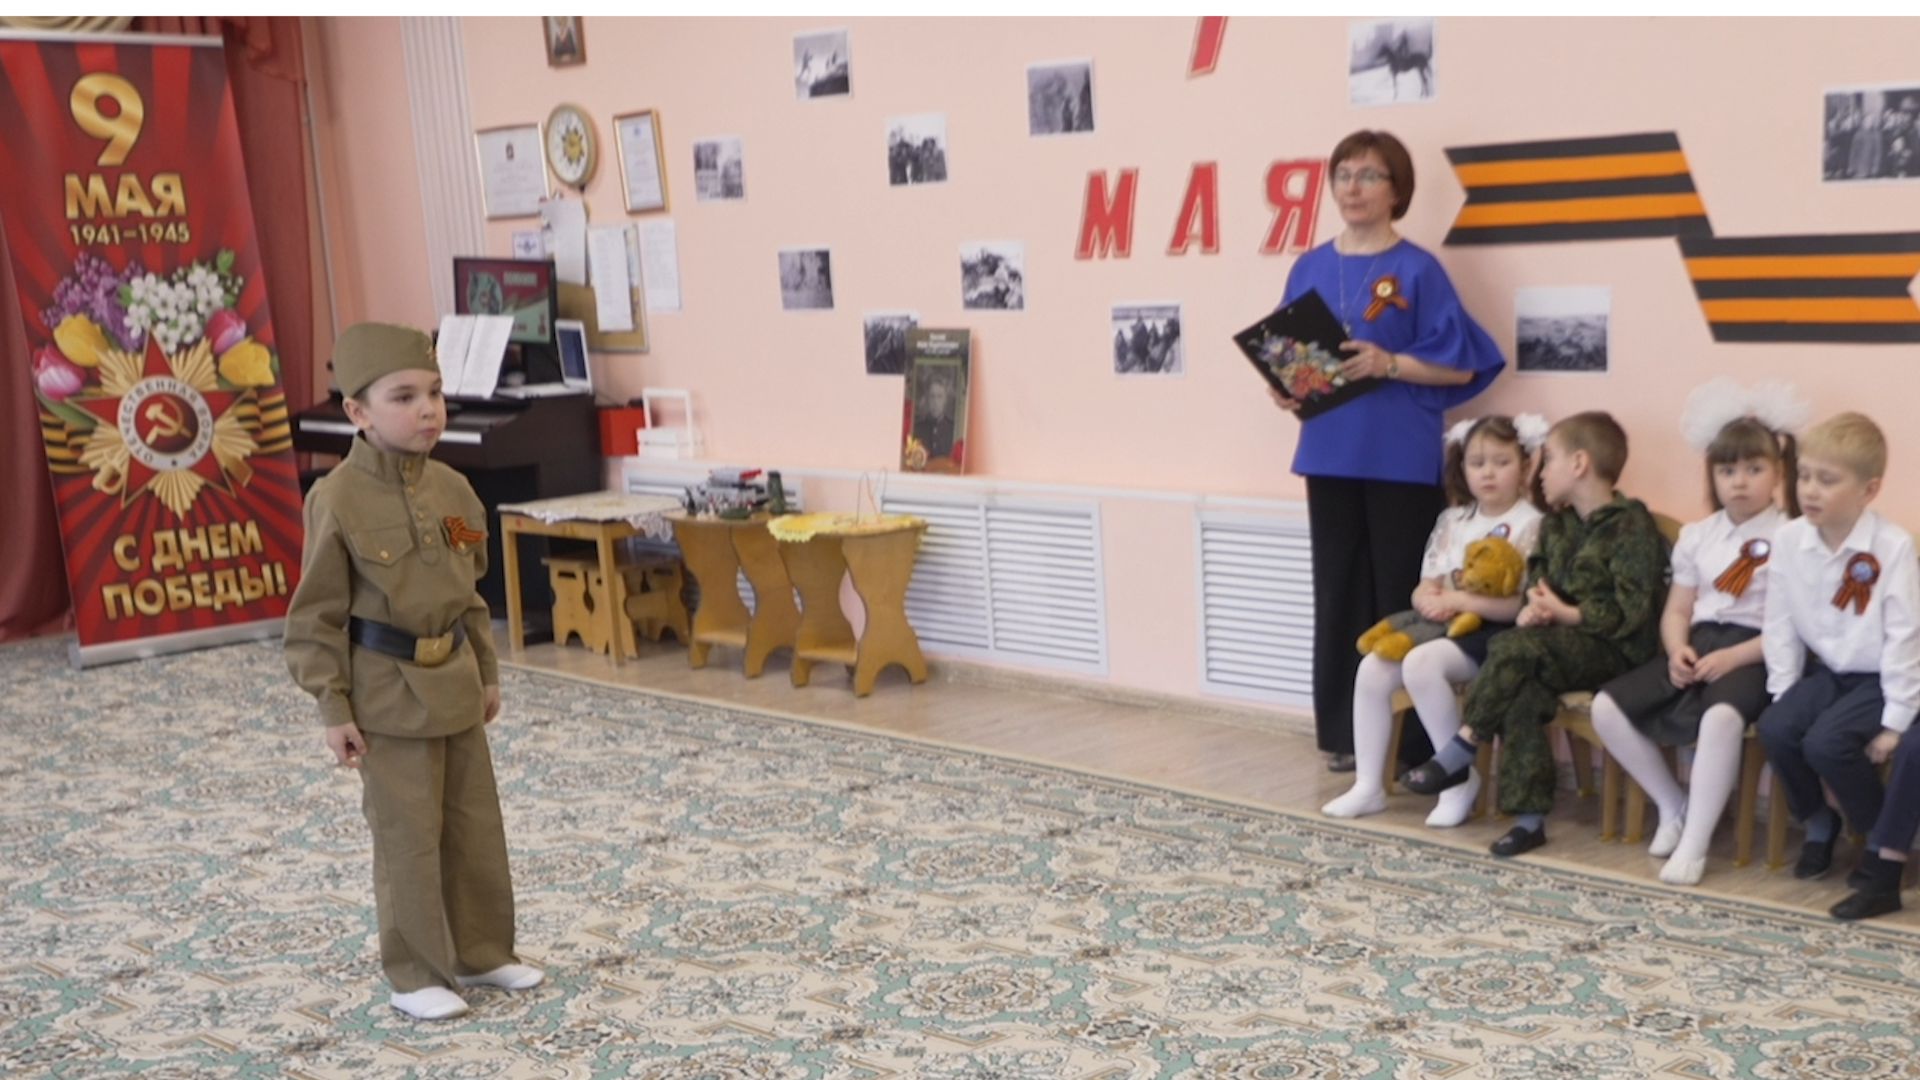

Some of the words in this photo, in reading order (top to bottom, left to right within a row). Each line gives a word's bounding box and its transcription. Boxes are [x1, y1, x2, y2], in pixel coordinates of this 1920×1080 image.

[70, 72, 144, 166] 9
[65, 173, 186, 219] МАЯ
[1074, 156, 1328, 260] МАЯ
[113, 534, 141, 572] С
[152, 519, 264, 573] ДНЕМ
[102, 561, 287, 620] ПОБЕДЫ!
